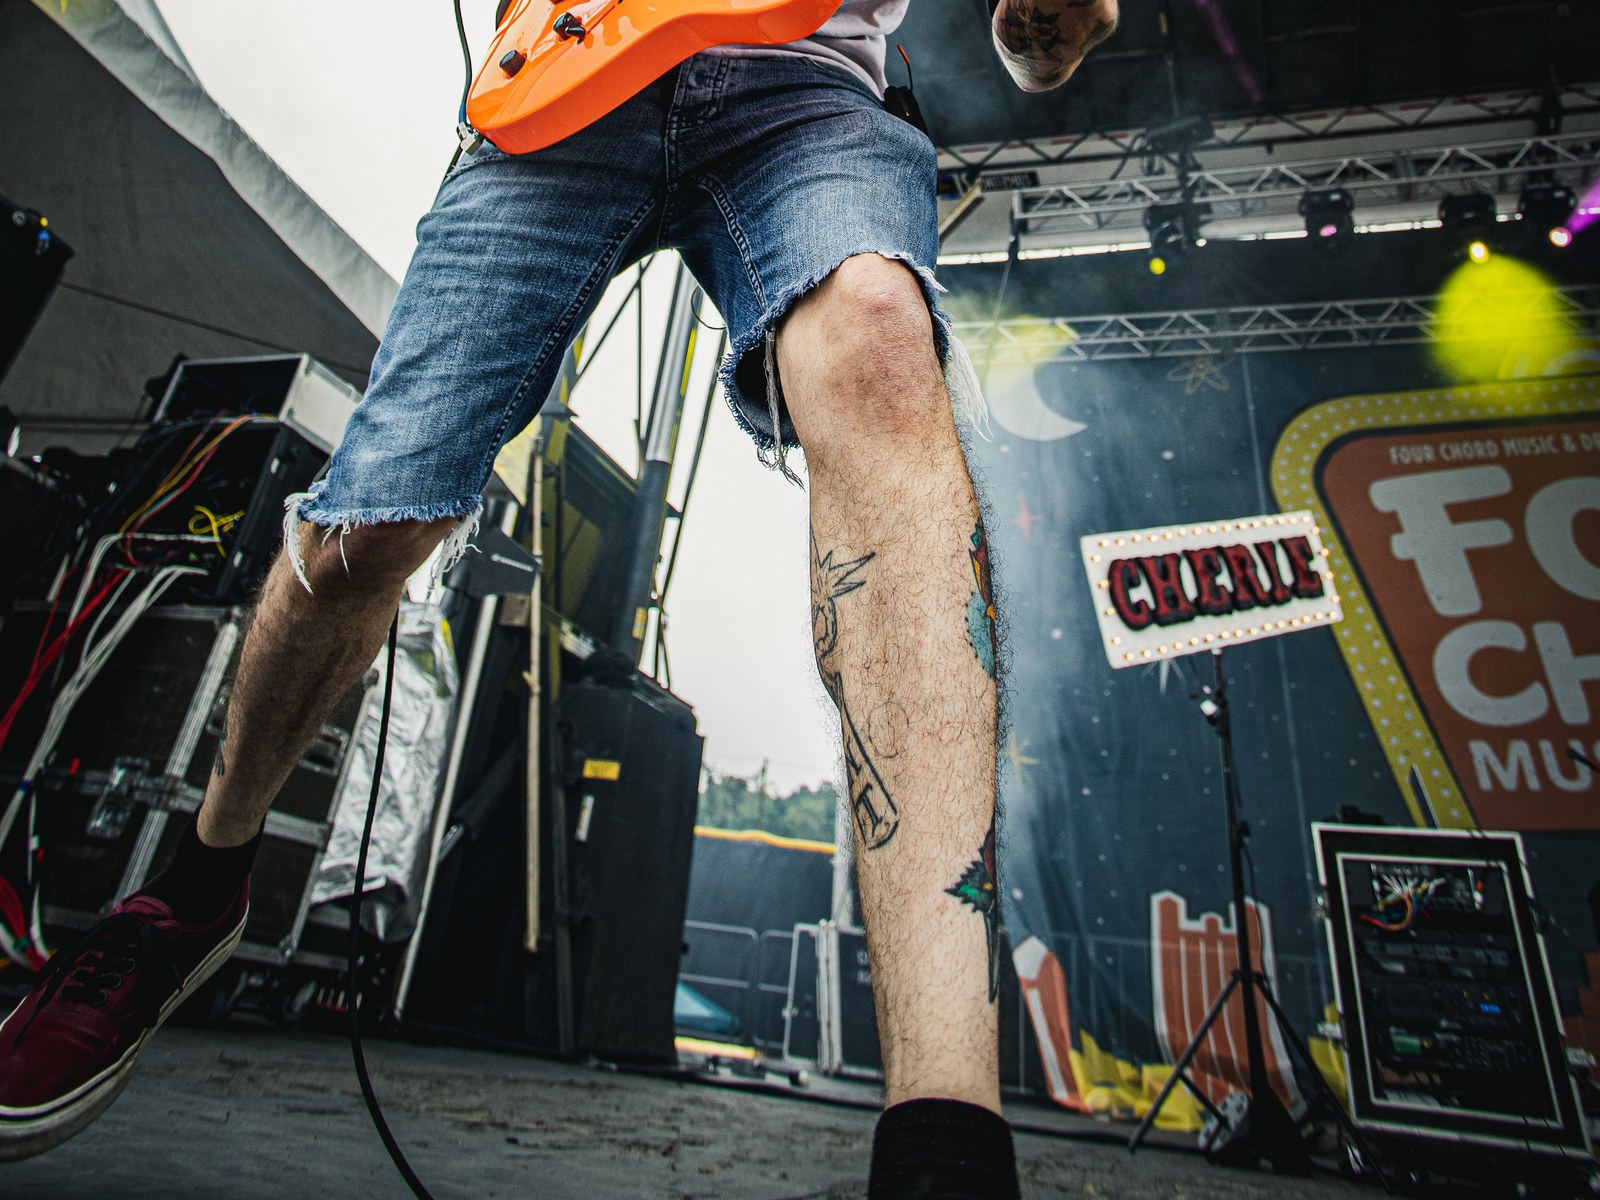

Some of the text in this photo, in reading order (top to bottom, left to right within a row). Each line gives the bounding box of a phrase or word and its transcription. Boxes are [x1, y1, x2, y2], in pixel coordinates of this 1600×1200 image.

[1388, 442, 1436, 466] FOUR
[1438, 438, 1500, 462] CHORD
[1502, 434, 1558, 458] MUSIC
[1561, 432, 1577, 453] &
[1108, 535, 1325, 631] CHERIE
[1467, 738, 1600, 792] MU
